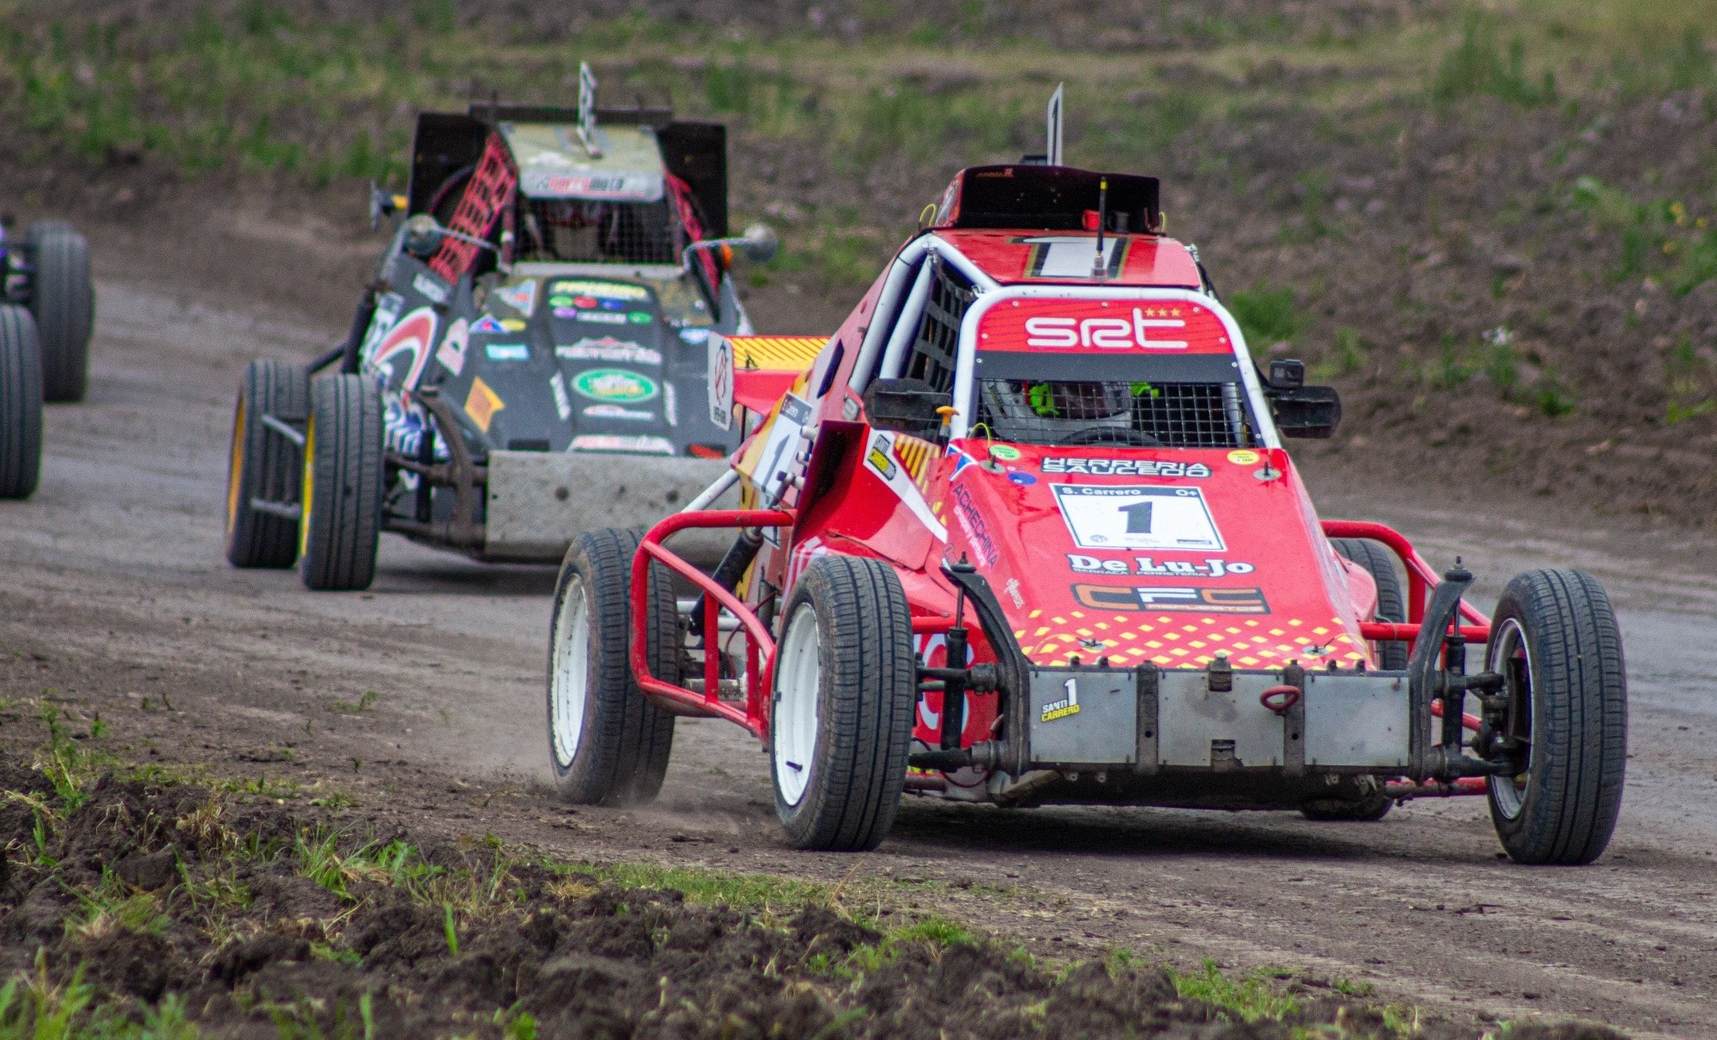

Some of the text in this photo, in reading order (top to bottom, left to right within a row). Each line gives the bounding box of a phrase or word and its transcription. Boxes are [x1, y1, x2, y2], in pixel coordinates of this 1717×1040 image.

[1016, 236, 1123, 278] 1
[1042, 457, 1208, 471] HERRERIA
[1042, 464, 1212, 477] SAUCEDO
[1062, 487, 1142, 496] S. Carrero
[1117, 501, 1153, 534] 1
[1067, 554, 1254, 577] De Lu-Jo
[1064, 678, 1077, 706] 1
[1041, 704, 1080, 722] CARRERO
[1042, 699, 1068, 713] SANTI
